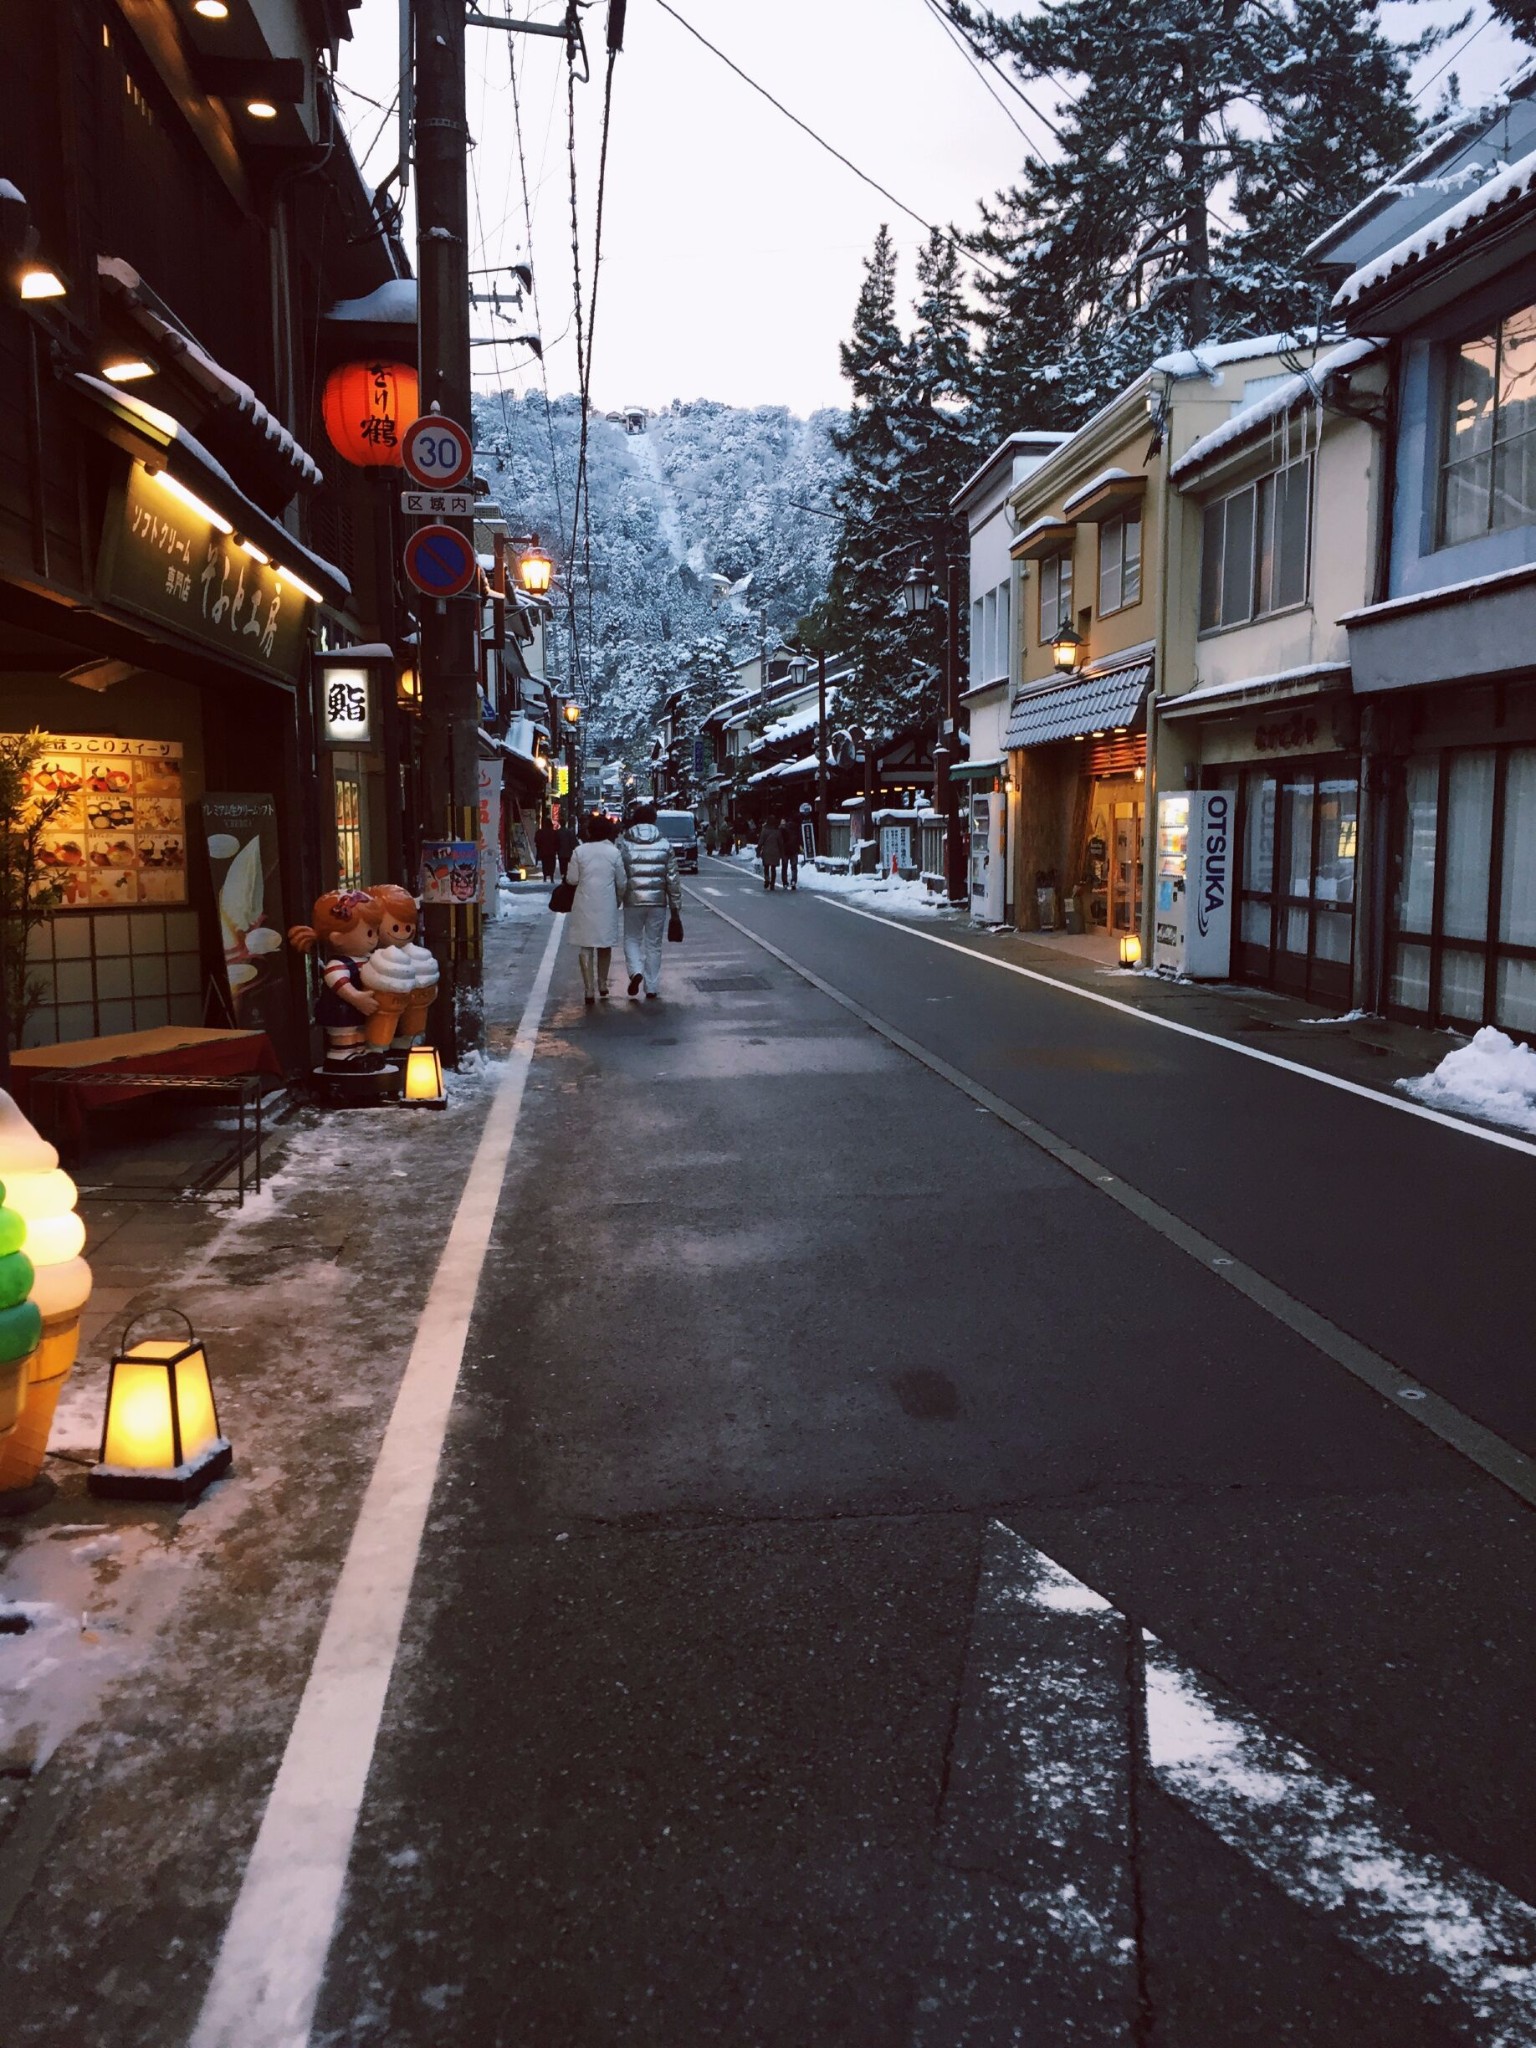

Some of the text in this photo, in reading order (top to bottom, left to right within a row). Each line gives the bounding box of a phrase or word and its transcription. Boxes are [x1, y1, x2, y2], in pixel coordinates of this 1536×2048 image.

[419, 437, 457, 469] 30
[408, 496, 467, 512] 区域内
[132, 505, 191, 564] ソフトクリーム
[165, 566, 192, 602] 専門店
[328, 683, 366, 723] 鮨
[1204, 795, 1228, 914] OTSUKA
